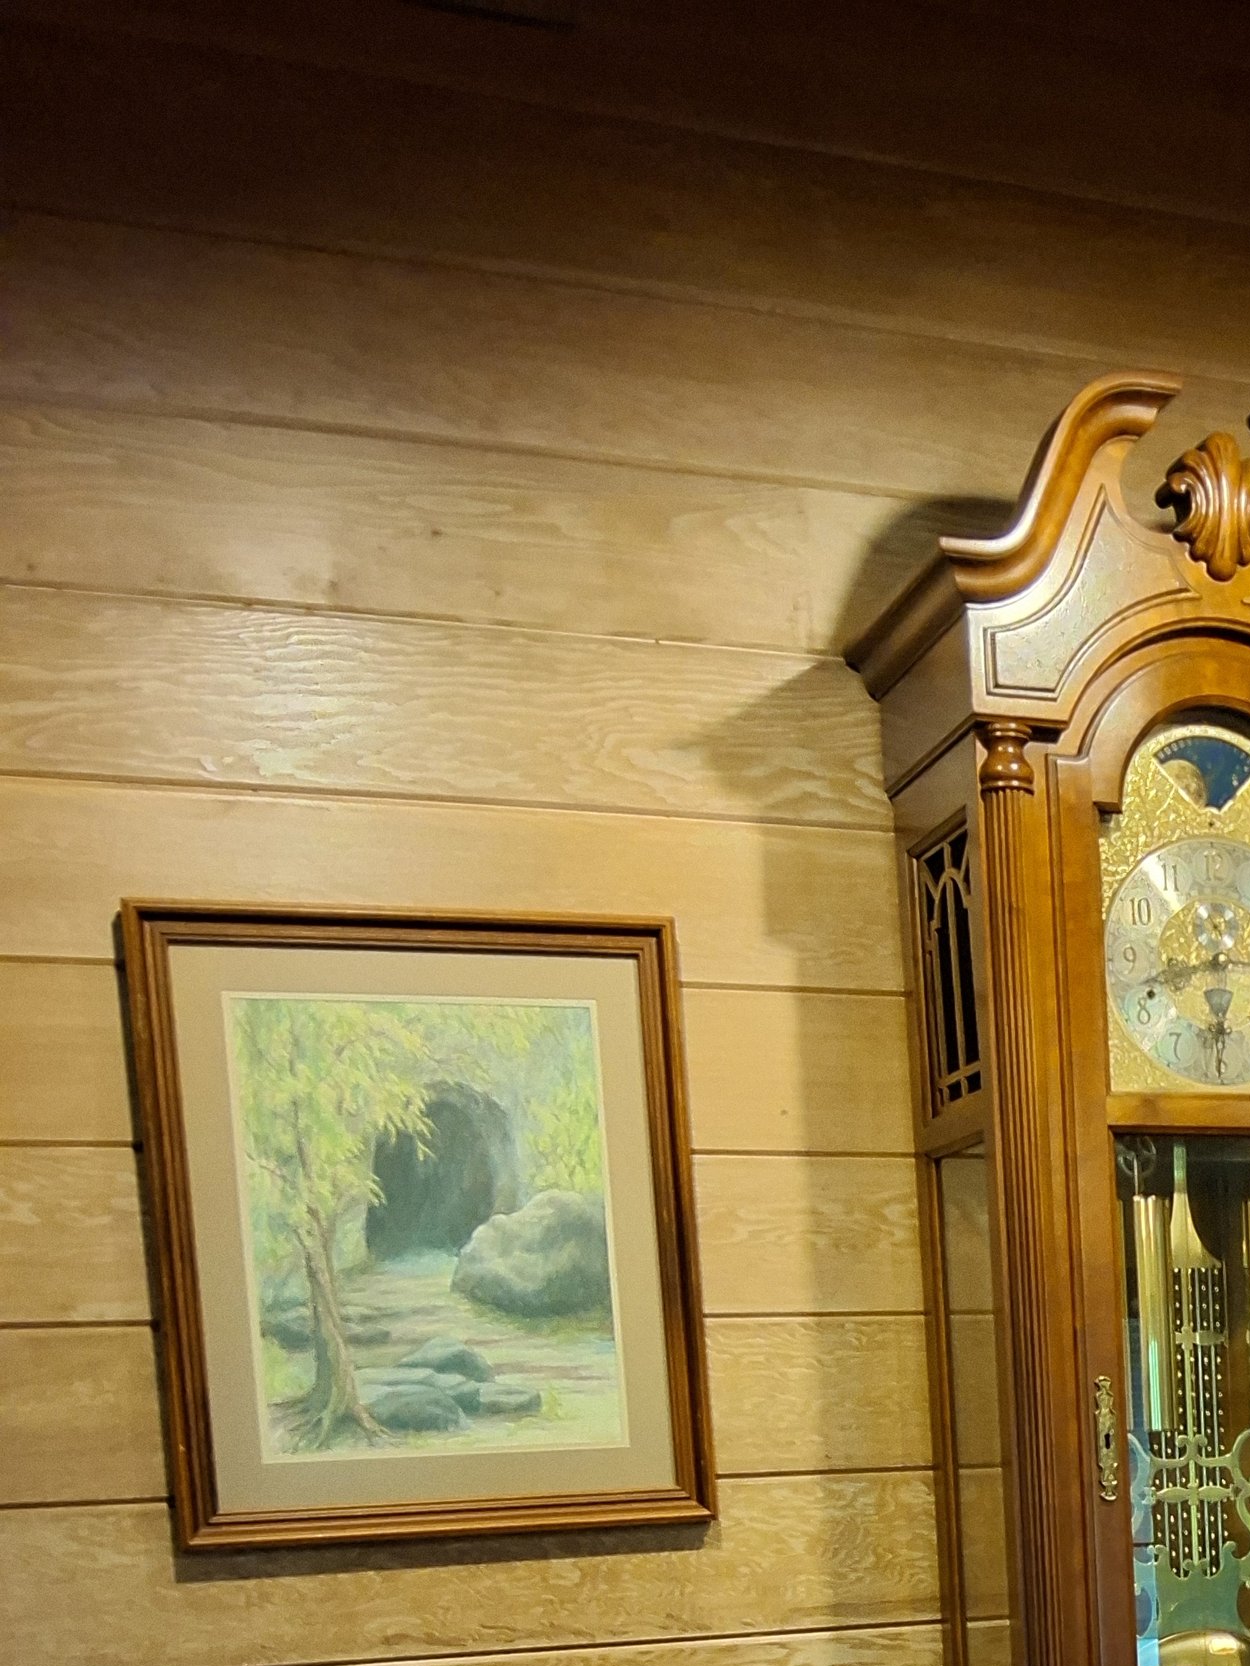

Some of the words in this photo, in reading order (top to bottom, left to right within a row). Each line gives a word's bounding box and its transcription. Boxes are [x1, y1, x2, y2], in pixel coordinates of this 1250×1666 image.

[1161, 863, 1179, 892] 11
[1204, 853, 1224, 882] 12
[1129, 897, 1151, 926] 10
[1122, 946, 1137, 975] 9
[1137, 996, 1151, 1025] 8
[1168, 1032, 1183, 1062] 7
